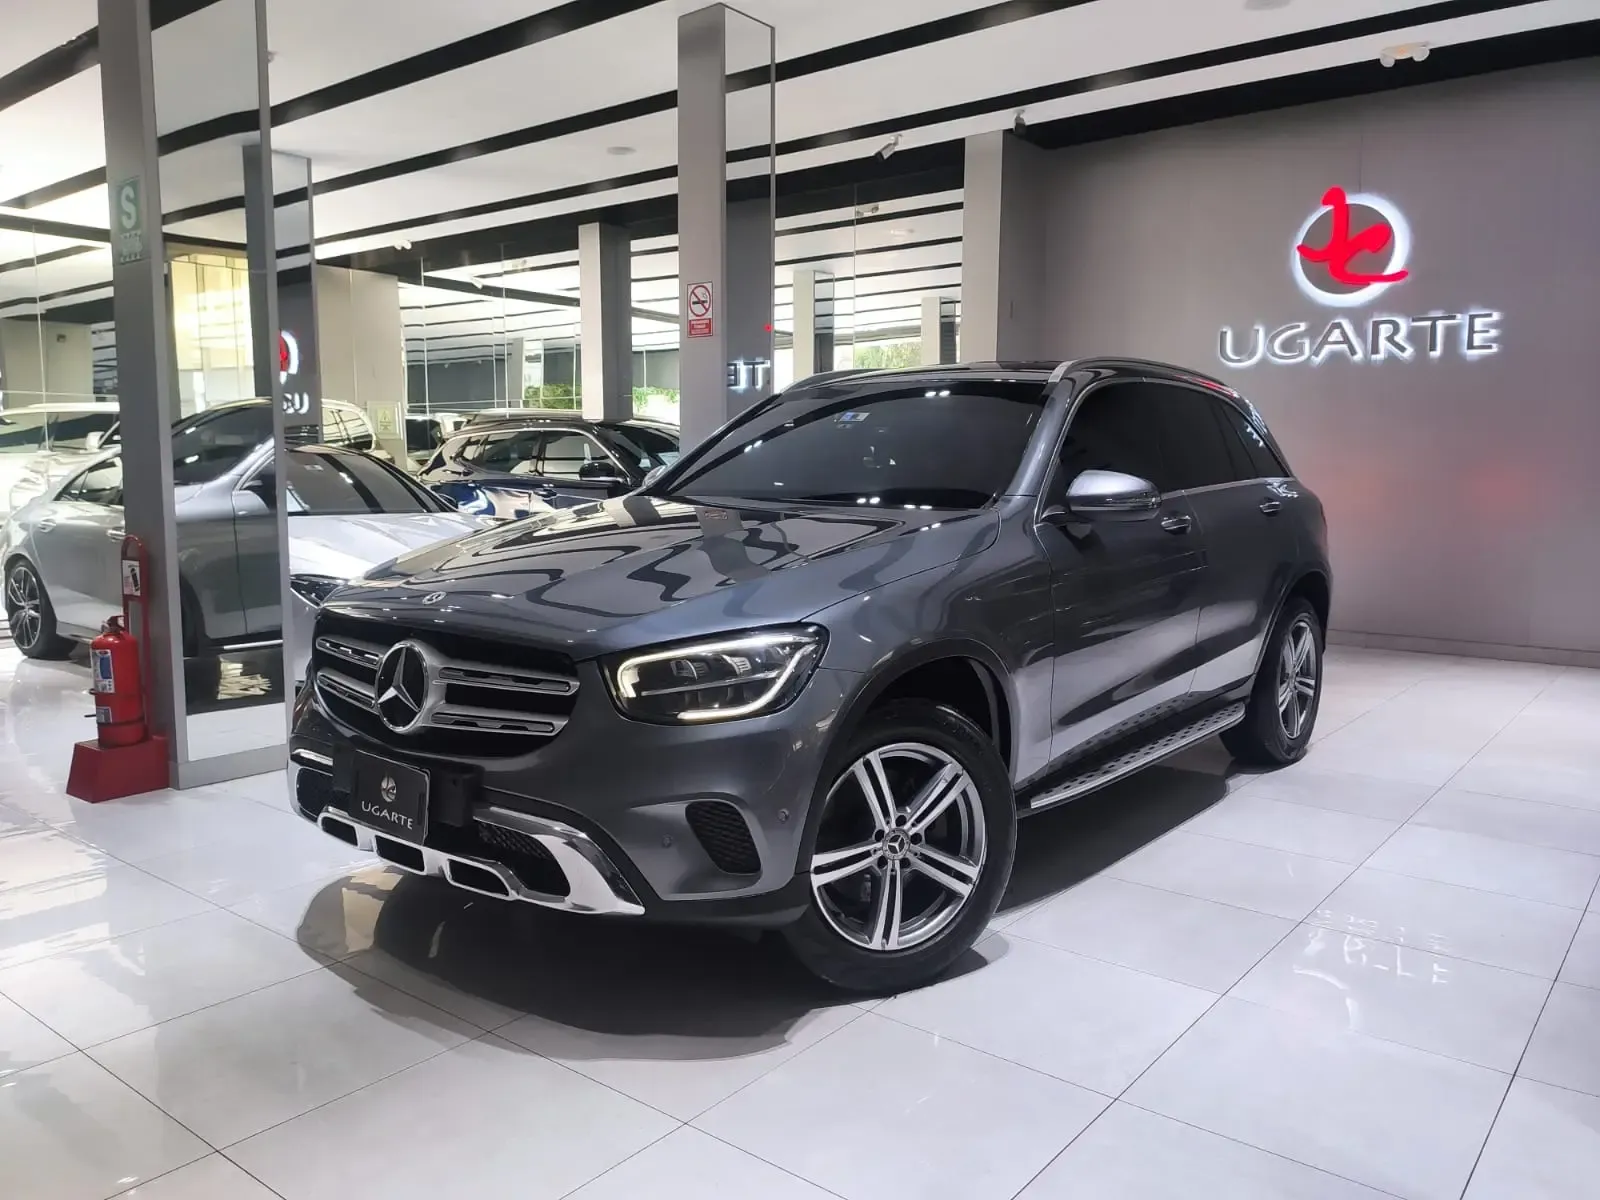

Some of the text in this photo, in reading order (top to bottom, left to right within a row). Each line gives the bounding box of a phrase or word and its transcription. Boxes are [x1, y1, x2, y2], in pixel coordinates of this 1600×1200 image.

[120, 185, 137, 229] S
[1218, 311, 1502, 367] UGARTE
[361, 800, 414, 831] UGARTE
